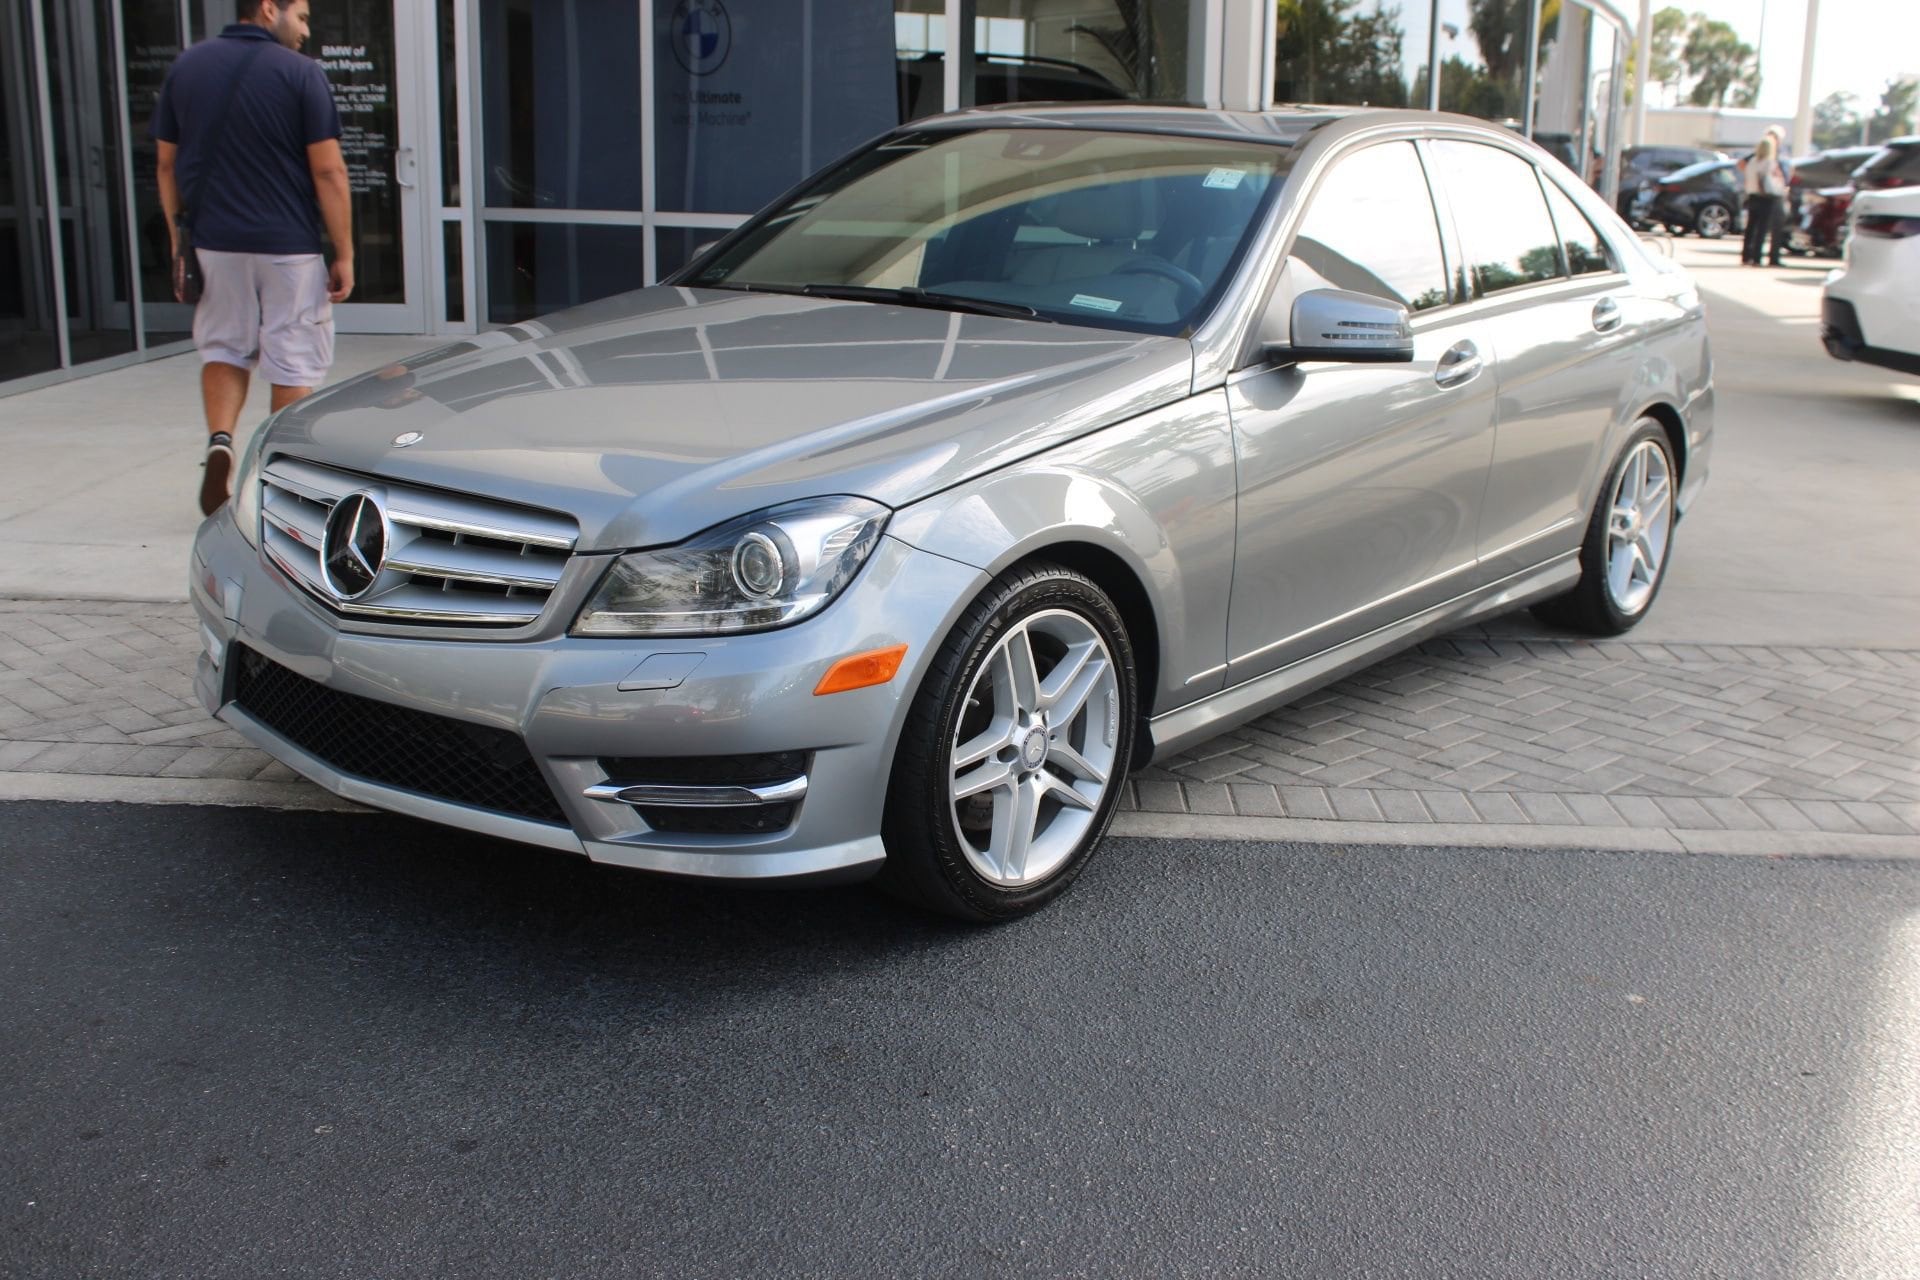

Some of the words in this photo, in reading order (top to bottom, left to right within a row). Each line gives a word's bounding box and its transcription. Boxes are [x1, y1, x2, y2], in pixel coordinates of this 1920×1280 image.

[321, 45, 352, 57] BMW
[353, 45, 366, 57] of
[339, 59, 374, 72] Myers
